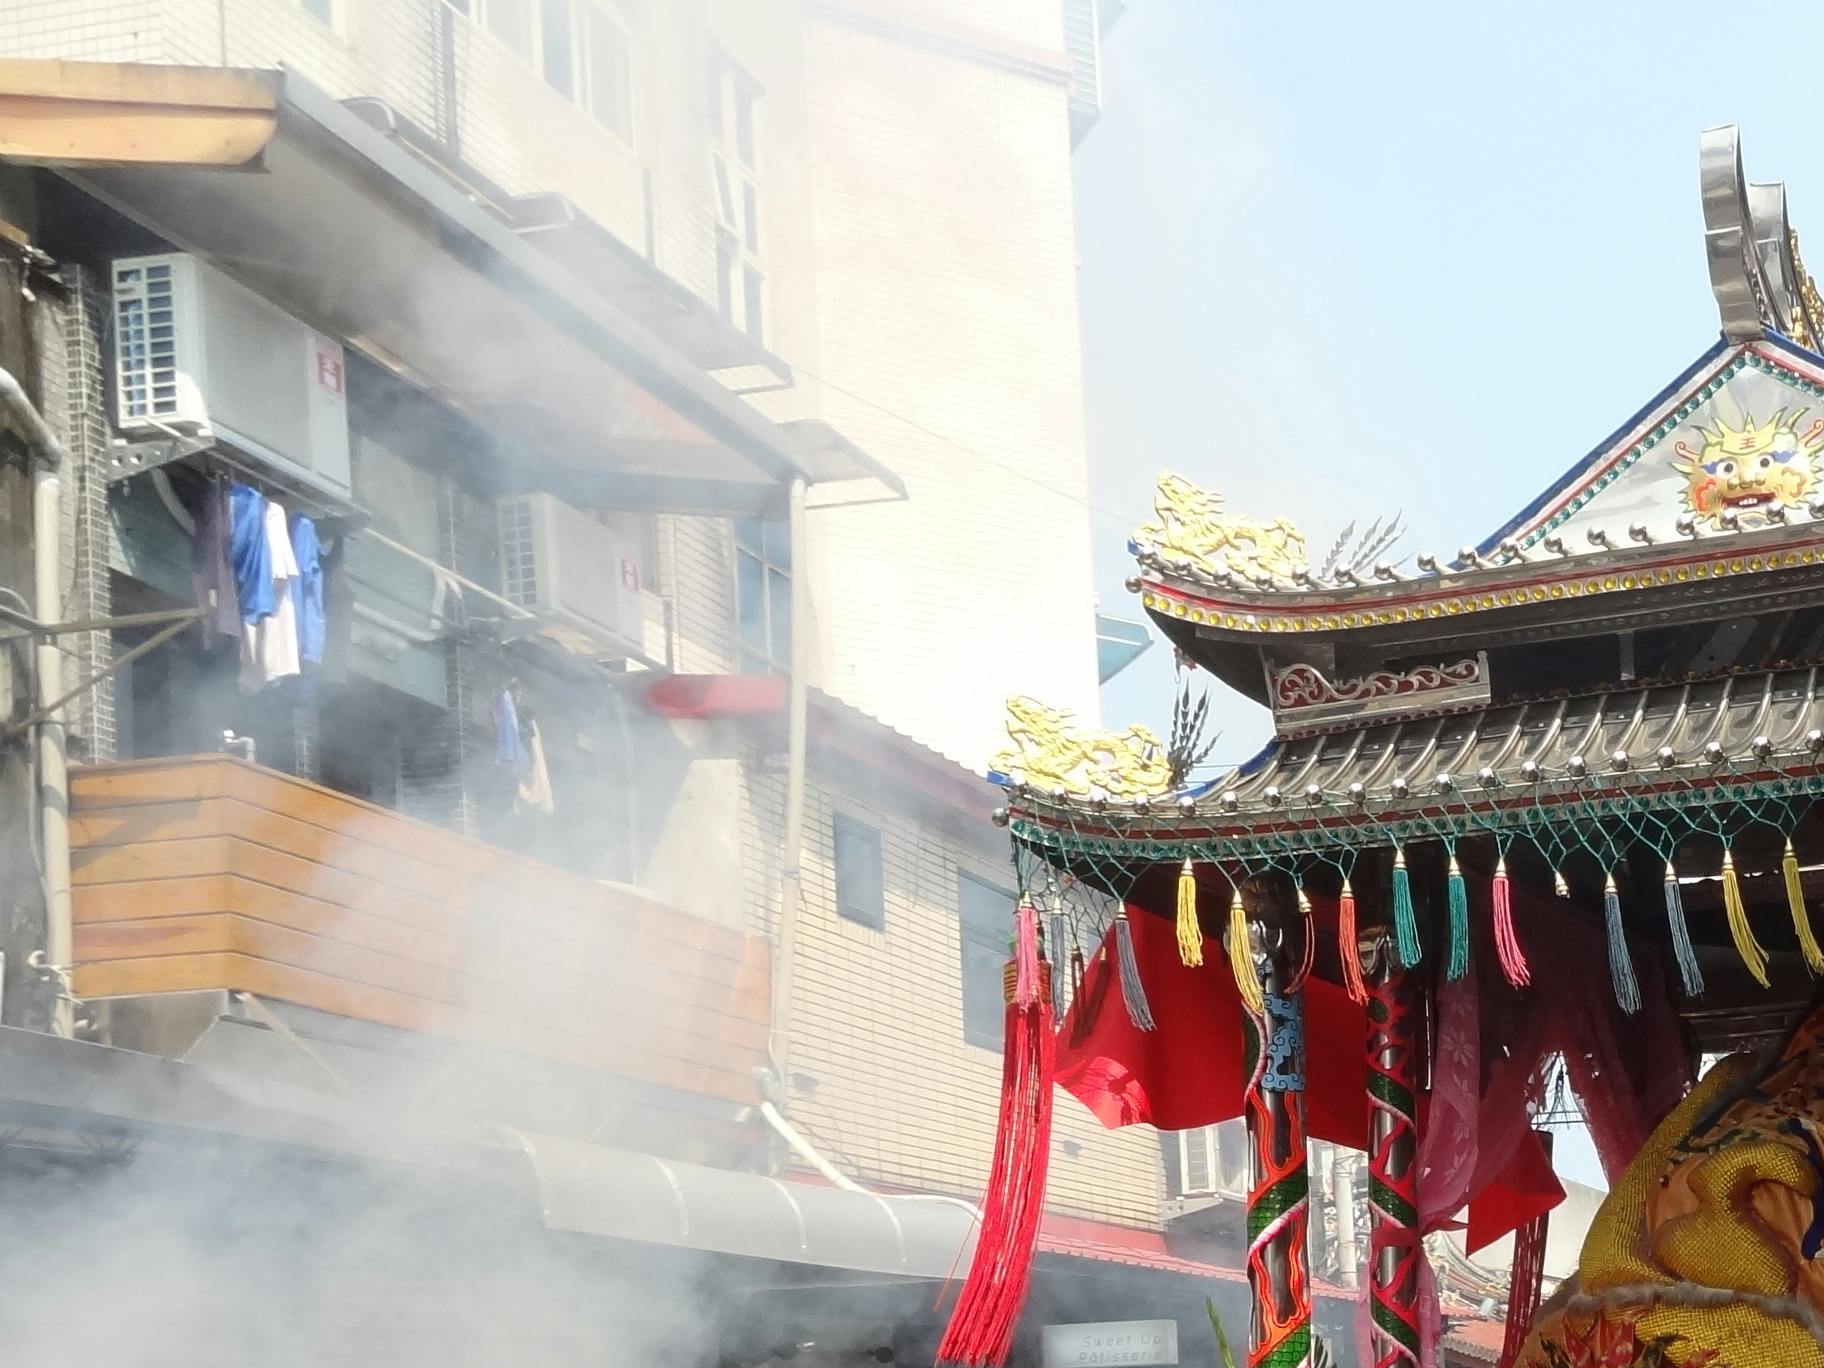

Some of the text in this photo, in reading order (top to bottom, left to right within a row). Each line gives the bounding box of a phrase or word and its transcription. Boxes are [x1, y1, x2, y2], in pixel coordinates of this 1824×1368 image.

[1739, 437, 1756, 450] 王
[1081, 1334, 1162, 1348] Sweet Up
